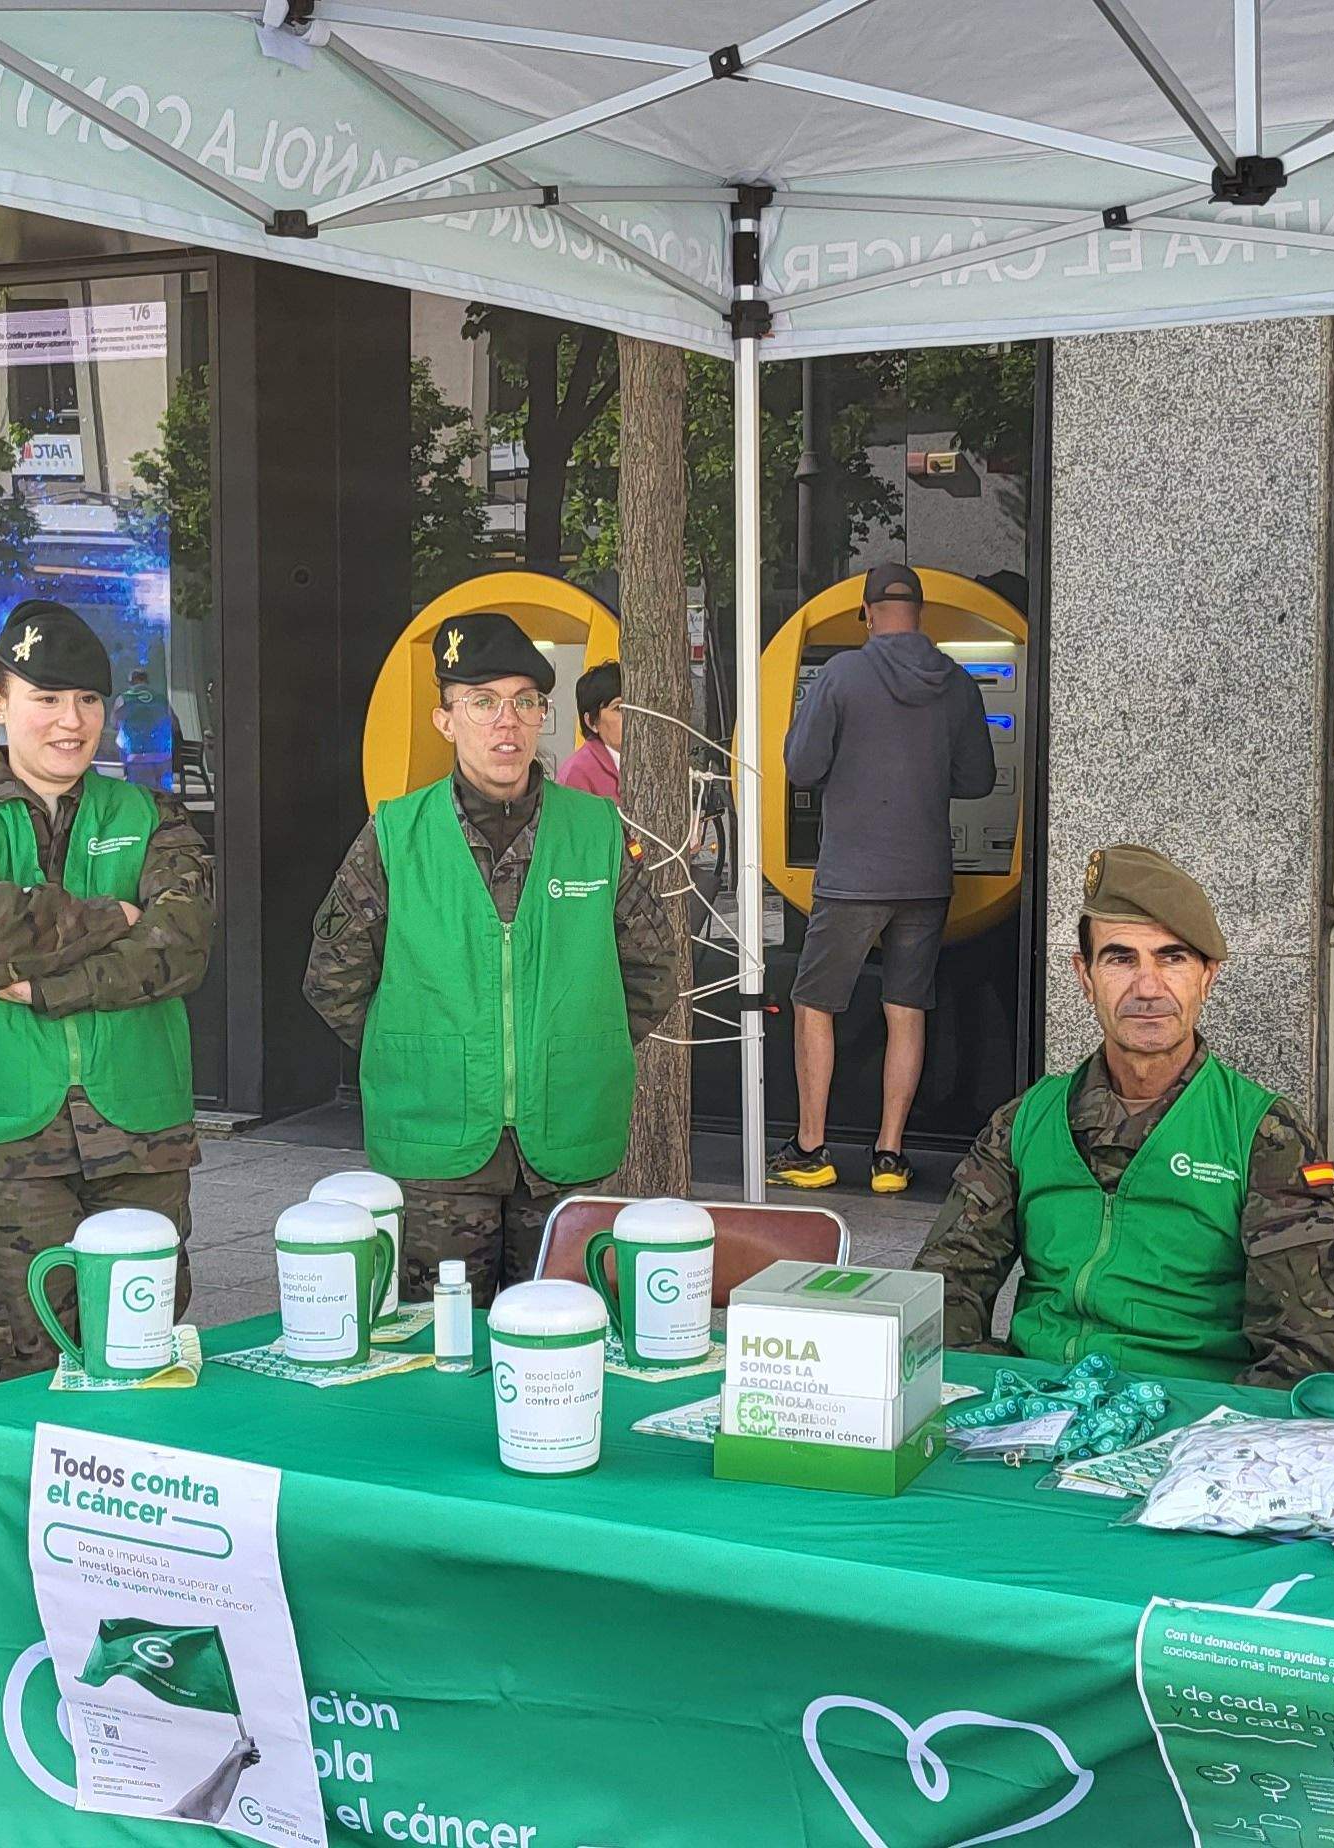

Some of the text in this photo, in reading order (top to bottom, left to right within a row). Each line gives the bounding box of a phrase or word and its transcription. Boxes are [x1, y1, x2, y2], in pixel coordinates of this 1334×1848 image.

[129, 303, 151, 322] 1/6
[741, 1335, 821, 1362] HOLA
[524, 1370, 581, 1381] asociación
[739, 1361, 813, 1378] SOMOS LA
[739, 1376, 828, 1394] ASOCIACIÓN
[525, 1397, 560, 1406] contra
[784, 1427, 877, 1444] contra el cáncer
[51, 1447, 219, 1507] Todos contra
[47, 1480, 168, 1526] el cáncer
[78, 1541, 105, 1557] Dona
[107, 1549, 115, 1558] e
[160, 1556, 170, 1568] la
[81, 1573, 104, 1585] 70%
[106, 1576, 120, 1588] de
[122, 1581, 197, 1602] supervivencia
[199, 1595, 213, 1605] en
[151, 1572, 175, 1584] para
[177, 1577, 219, 1592] superar
[221, 1583, 232, 1594] el
[1165, 1628, 1187, 1642] Con
[1190, 1631, 1203, 1644] tu
[1204, 1634, 1258, 1654] donación
[1260, 1645, 1281, 1658] nos
[1283, 1650, 1327, 1667] ayudas
[1163, 1645, 1239, 1667] sociosanitario
[1240, 1658, 1265, 1671] más
[1267, 1662, 1330, 1683] importante
[310, 1690, 399, 1731] ción
[1164, 1684, 1177, 1698] 1
[1182, 1685, 1213, 1703] de
[1219, 1694, 1278, 1714] cada
[1286, 1704, 1299, 1718] 2
[1170, 1704, 1183, 1718] y
[1190, 1707, 1202, 1718] 1
[1207, 1708, 1239, 1724] de
[1245, 1716, 1305, 1732] cada
[1311, 1725, 1326, 1737] 3
[336, 1797, 537, 1848] el cáncer
